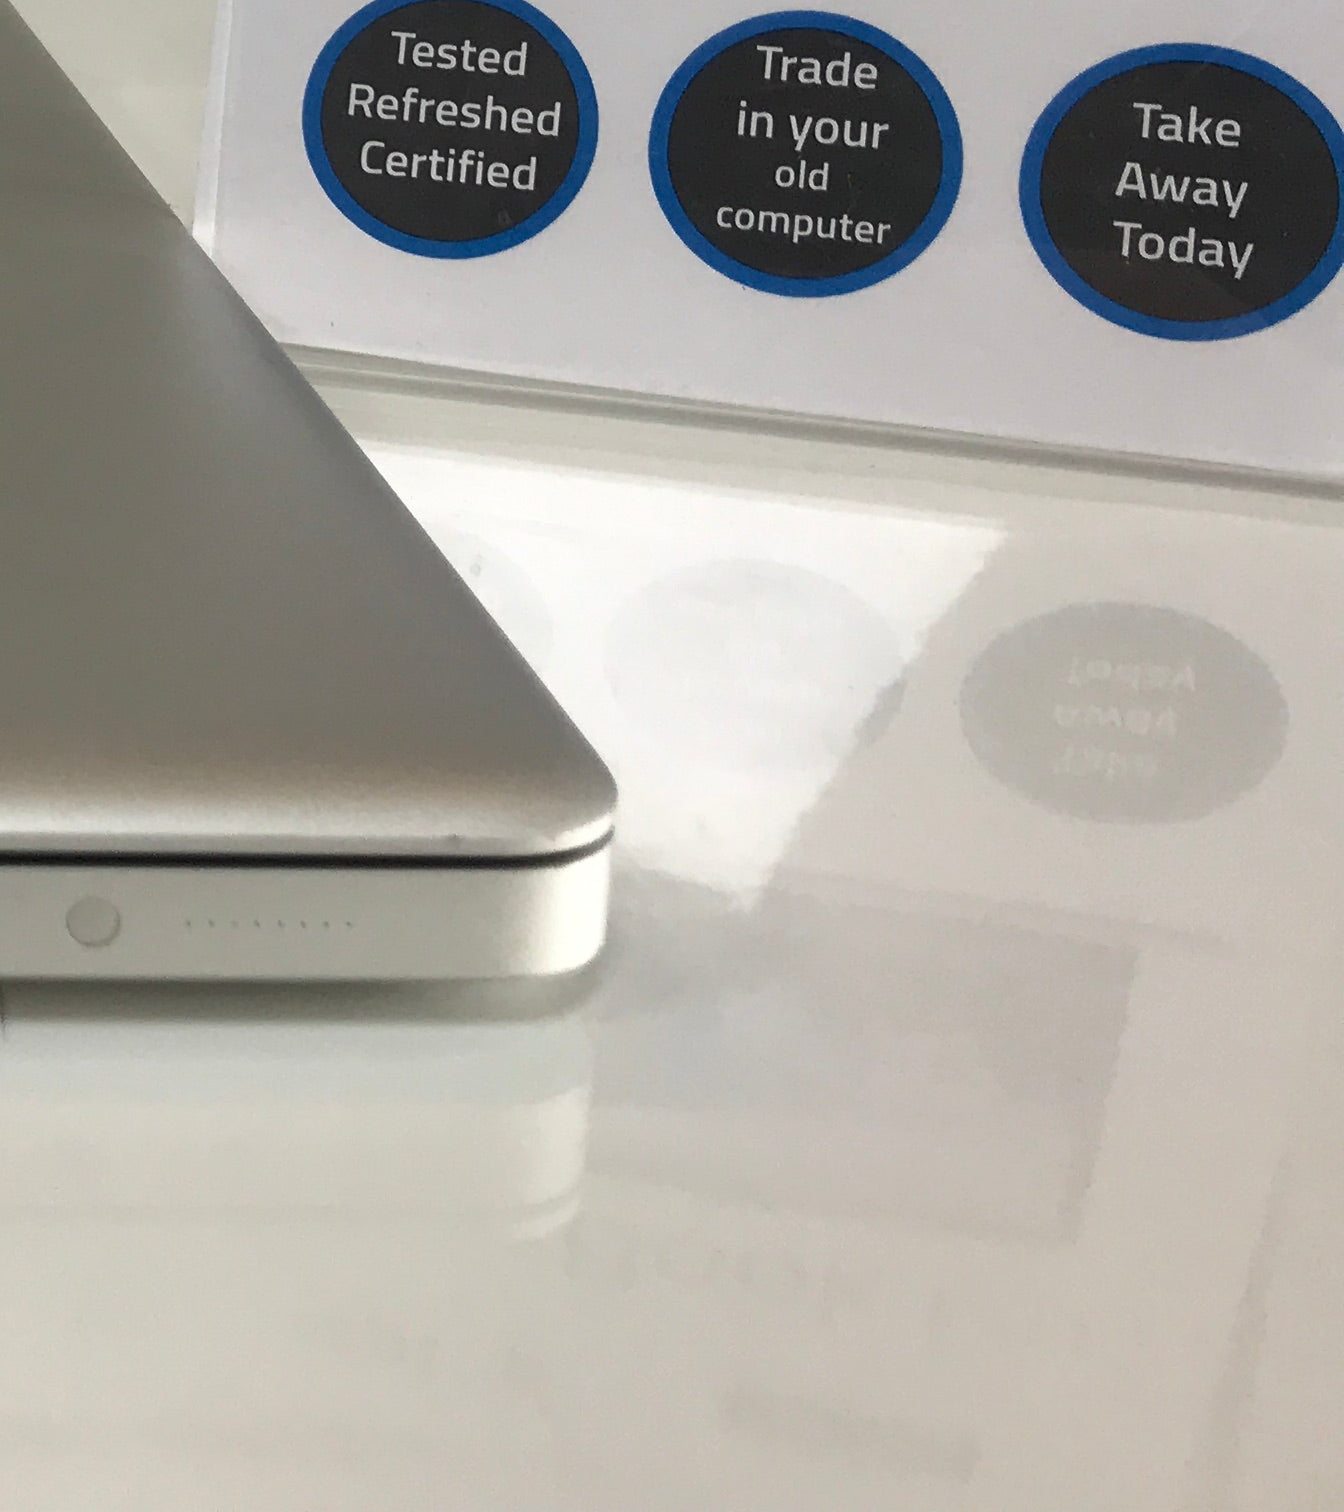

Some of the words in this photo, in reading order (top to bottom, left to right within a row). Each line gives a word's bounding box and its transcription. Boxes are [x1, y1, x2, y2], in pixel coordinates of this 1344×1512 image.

[391, 31, 527, 75] Tested
[757, 45, 877, 89] Trade
[348, 83, 561, 136] Refreshed
[738, 101, 773, 138] in
[790, 115, 889, 151] your
[1133, 103, 1240, 146] Take
[361, 140, 538, 190] Certified
[775, 160, 829, 190] old
[1114, 162, 1248, 219] Away
[717, 207, 891, 244] computer
[1113, 221, 1253, 279] Today
